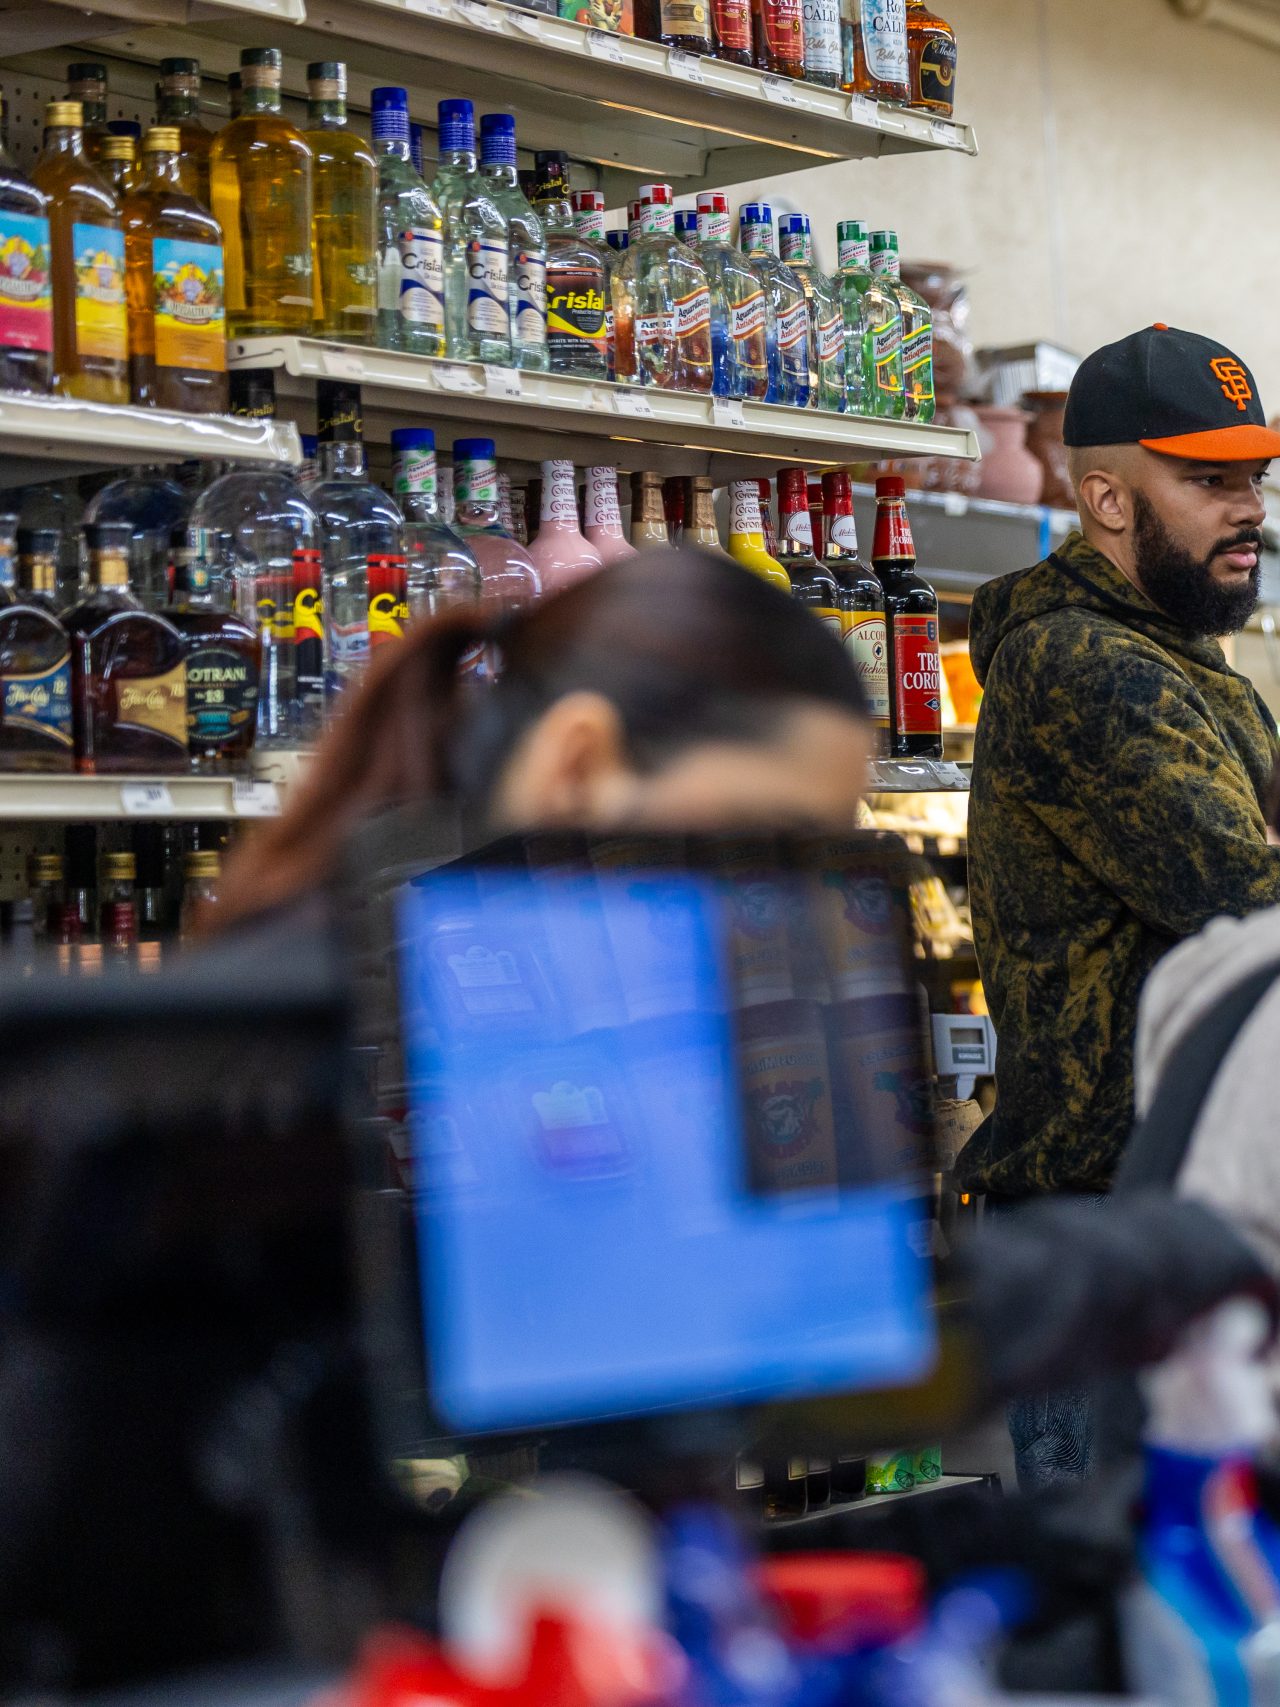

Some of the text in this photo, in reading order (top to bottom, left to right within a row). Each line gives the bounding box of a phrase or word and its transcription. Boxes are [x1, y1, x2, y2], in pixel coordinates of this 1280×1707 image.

[794, 21, 799, 32] 5
[942, 65, 948, 76] 8
[1209, 357, 1252, 411] SF
[184, 666, 247, 682] OTRAN
